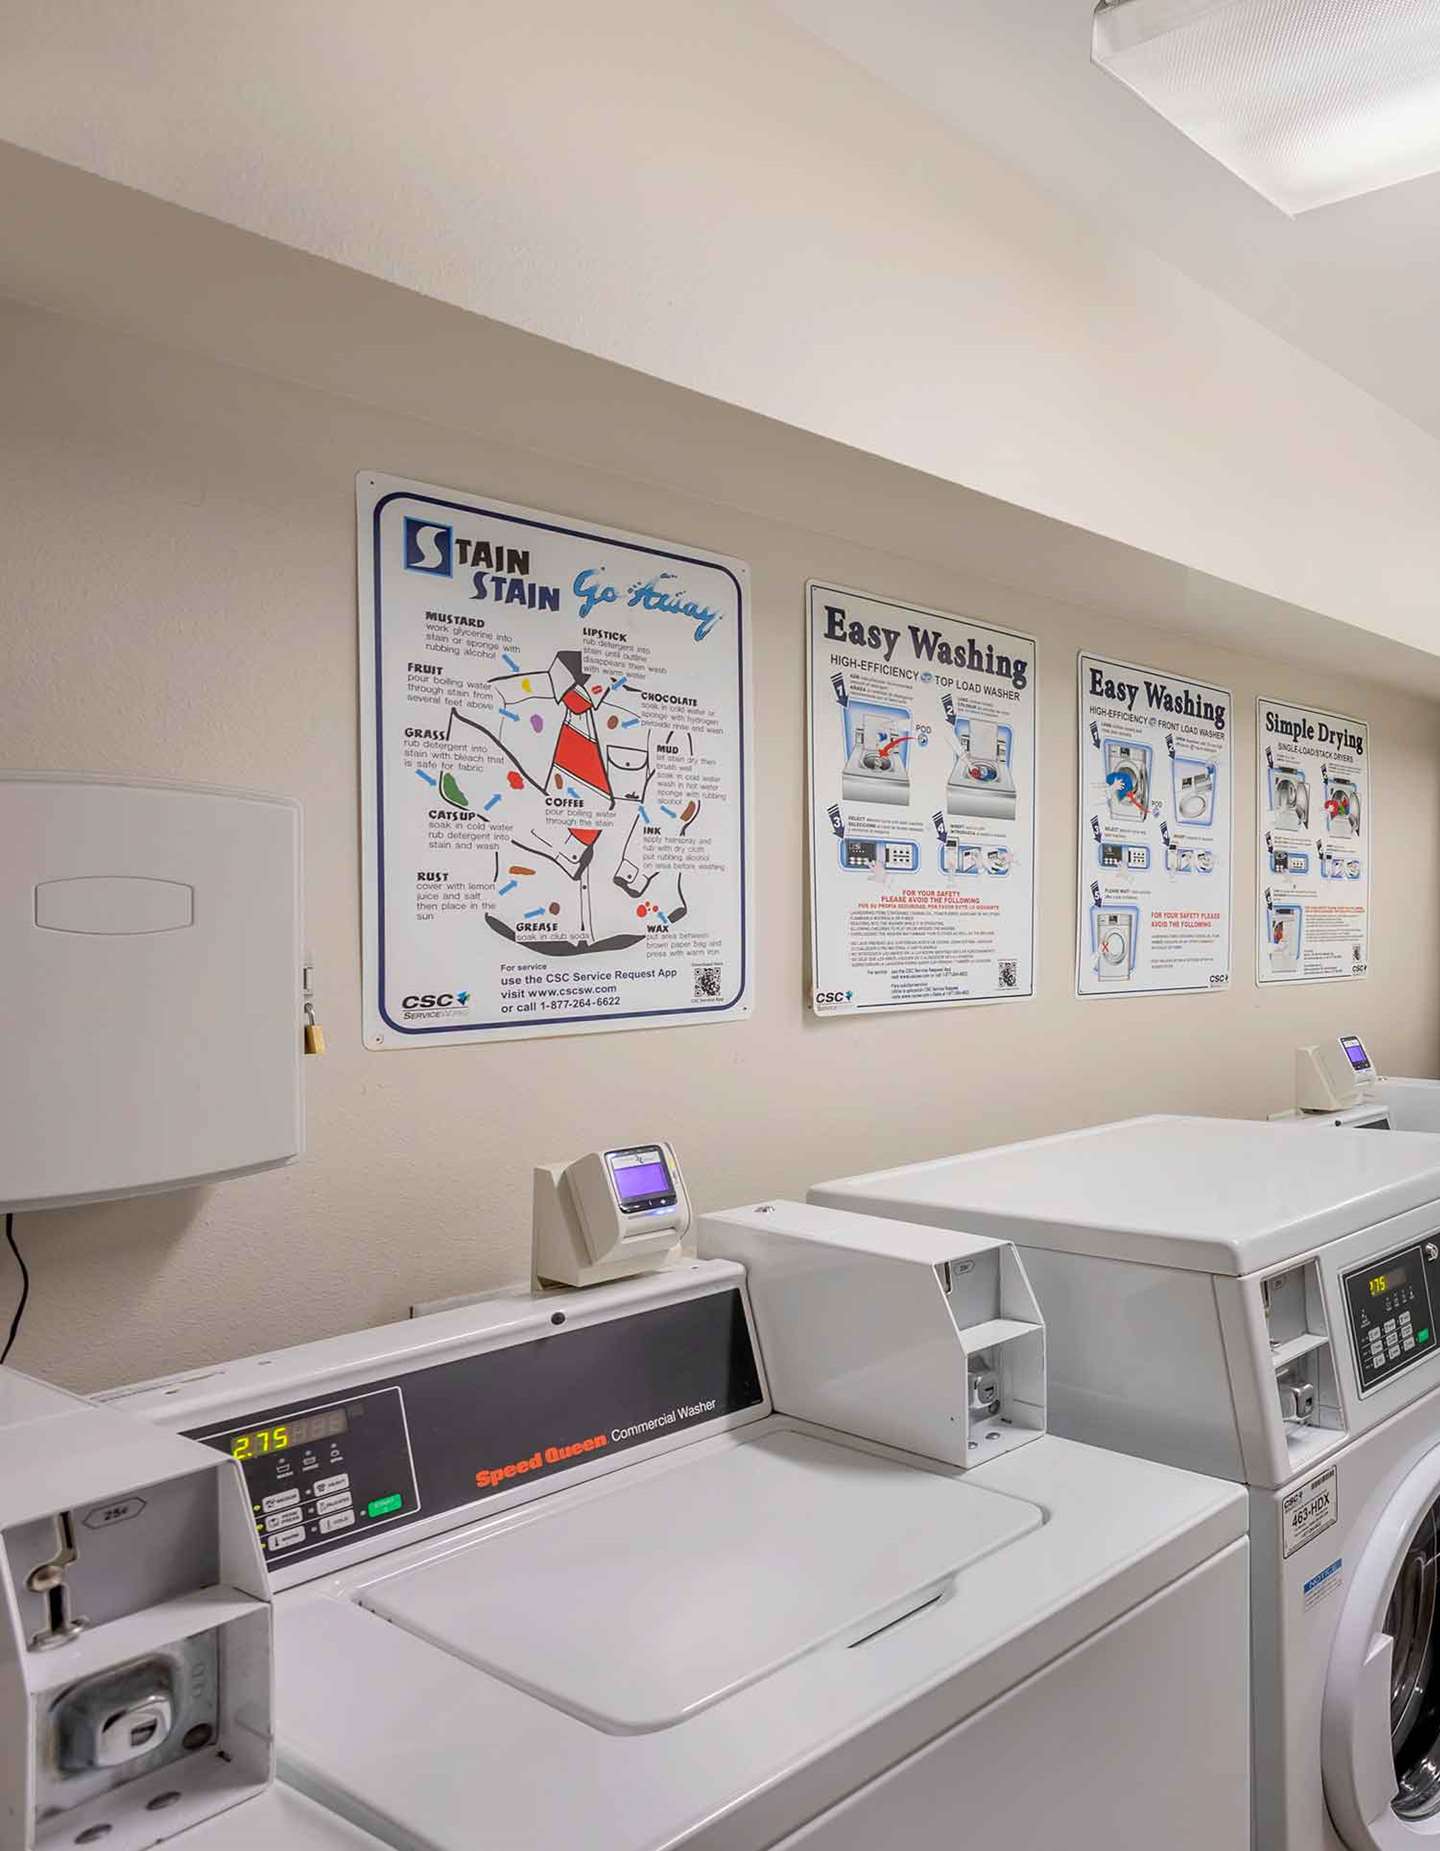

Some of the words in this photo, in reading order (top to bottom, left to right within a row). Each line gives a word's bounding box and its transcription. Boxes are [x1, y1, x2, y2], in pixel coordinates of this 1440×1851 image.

[410, 525, 530, 576] STAIN
[471, 571, 560, 612] STAIN
[572, 569, 618, 619] Go
[627, 576, 722, 641] Away
[425, 611, 485, 628] MUSTARD
[426, 624, 449, 634] work
[453, 626, 493, 640] glycerine
[496, 632, 512, 642] into
[583, 627, 627, 642] LIPSTICK
[426, 632, 449, 643] stain
[466, 640, 498, 652] sponge
[503, 643, 520, 653] with
[824, 605, 901, 662] Easy
[908, 625, 1028, 690] Washing
[425, 642, 460, 657] rubbing
[463, 647, 496, 659] alcohol
[407, 662, 443, 675] FRUIT
[408, 675, 429, 684] pour
[433, 675, 463, 690] boiling
[466, 680, 492, 691] water
[830, 654, 919, 681] HIGH-EFFICIENCY
[935, 674, 953, 689] TOP
[956, 678, 982, 696] LOAD
[984, 685, 1021, 702] WASHER
[407, 682, 444, 696] through
[447, 686, 470, 697] stain
[473, 689, 494, 700] from
[406, 694, 440, 704] several
[444, 695, 462, 706] feet
[466, 698, 494, 710] above
[641, 692, 698, 707] CHOCOLATE
[1089, 668, 1139, 711] Easy
[1143, 680, 1226, 730] Washing
[1089, 705, 1148, 726] HIGH-EFFICIENCY
[1157, 718, 1180, 732] FRONT
[1180, 724, 1198, 736] LOAD
[1199, 728, 1225, 740] WASHER
[405, 727, 446, 741] GRASS
[1265, 711, 1315, 742] Simple
[1318, 722, 1363, 755] Drying
[404, 739, 420, 749] rub
[422, 740, 468, 753] detergent
[471, 743, 488, 753] into
[657, 744, 679, 754] MUD
[404, 748, 428, 759] stain
[432, 750, 450, 760] with
[454, 752, 484, 762] bleach
[487, 754, 504, 764] that
[404, 758, 412, 767] is
[416, 759, 438, 769] safe
[441, 760, 454, 770] for
[458, 762, 484, 772] fabric
[545, 798, 584, 808] COFFEE
[428, 810, 476, 821] CATSUP
[833, 817, 840, 828] 3
[428, 820, 450, 829] soak
[455, 820, 463, 829] in
[466, 821, 486, 830] cold
[490, 822, 514, 831] water
[643, 827, 661, 835] INK
[428, 830, 444, 839] rub
[447, 830, 490, 842] detergent
[494, 832, 510, 841] into
[428, 840, 451, 849] stain
[454, 840, 472, 849] and
[476, 841, 500, 850] wash
[417, 872, 449, 881] RUST
[446, 881, 466, 890] with
[468, 881, 496, 890] lemon
[416, 891, 439, 902] juice
[442, 891, 461, 899] and
[464, 890, 481, 899] salt
[416, 901, 438, 910] then
[441, 901, 466, 912] place
[470, 901, 478, 909] in
[482, 901, 496, 909] the
[516, 922, 558, 932] GREASE
[647, 925, 669, 933] WAX
[500, 964, 515, 972] For
[517, 963, 547, 971] service
[501, 977, 522, 986] use
[525, 975, 542, 985] the
[546, 973, 570, 983] CSC
[573, 970, 611, 982] Service
[615, 969, 655, 981] Request
[658, 968, 677, 979] App
[1209, 975, 1225, 983] CSC
[501, 989, 525, 999] visit
[528, 985, 617, 998] www.cscsw.com
[816, 991, 844, 1004] CSC
[402, 994, 454, 1009] CSC
[501, 1005, 513, 1013] or
[516, 1001, 536, 1012] call
[541, 996, 621, 1011] 1-877-264-6622
[233, 1426, 289, 1460] 2.75
[475, 1451, 543, 1488] Speed
[545, 1433, 608, 1463] Queen
[611, 1411, 676, 1443] Commercial
[677, 1398, 717, 1419] Washer
[1292, 1492, 1331, 1528] 463-HDX
